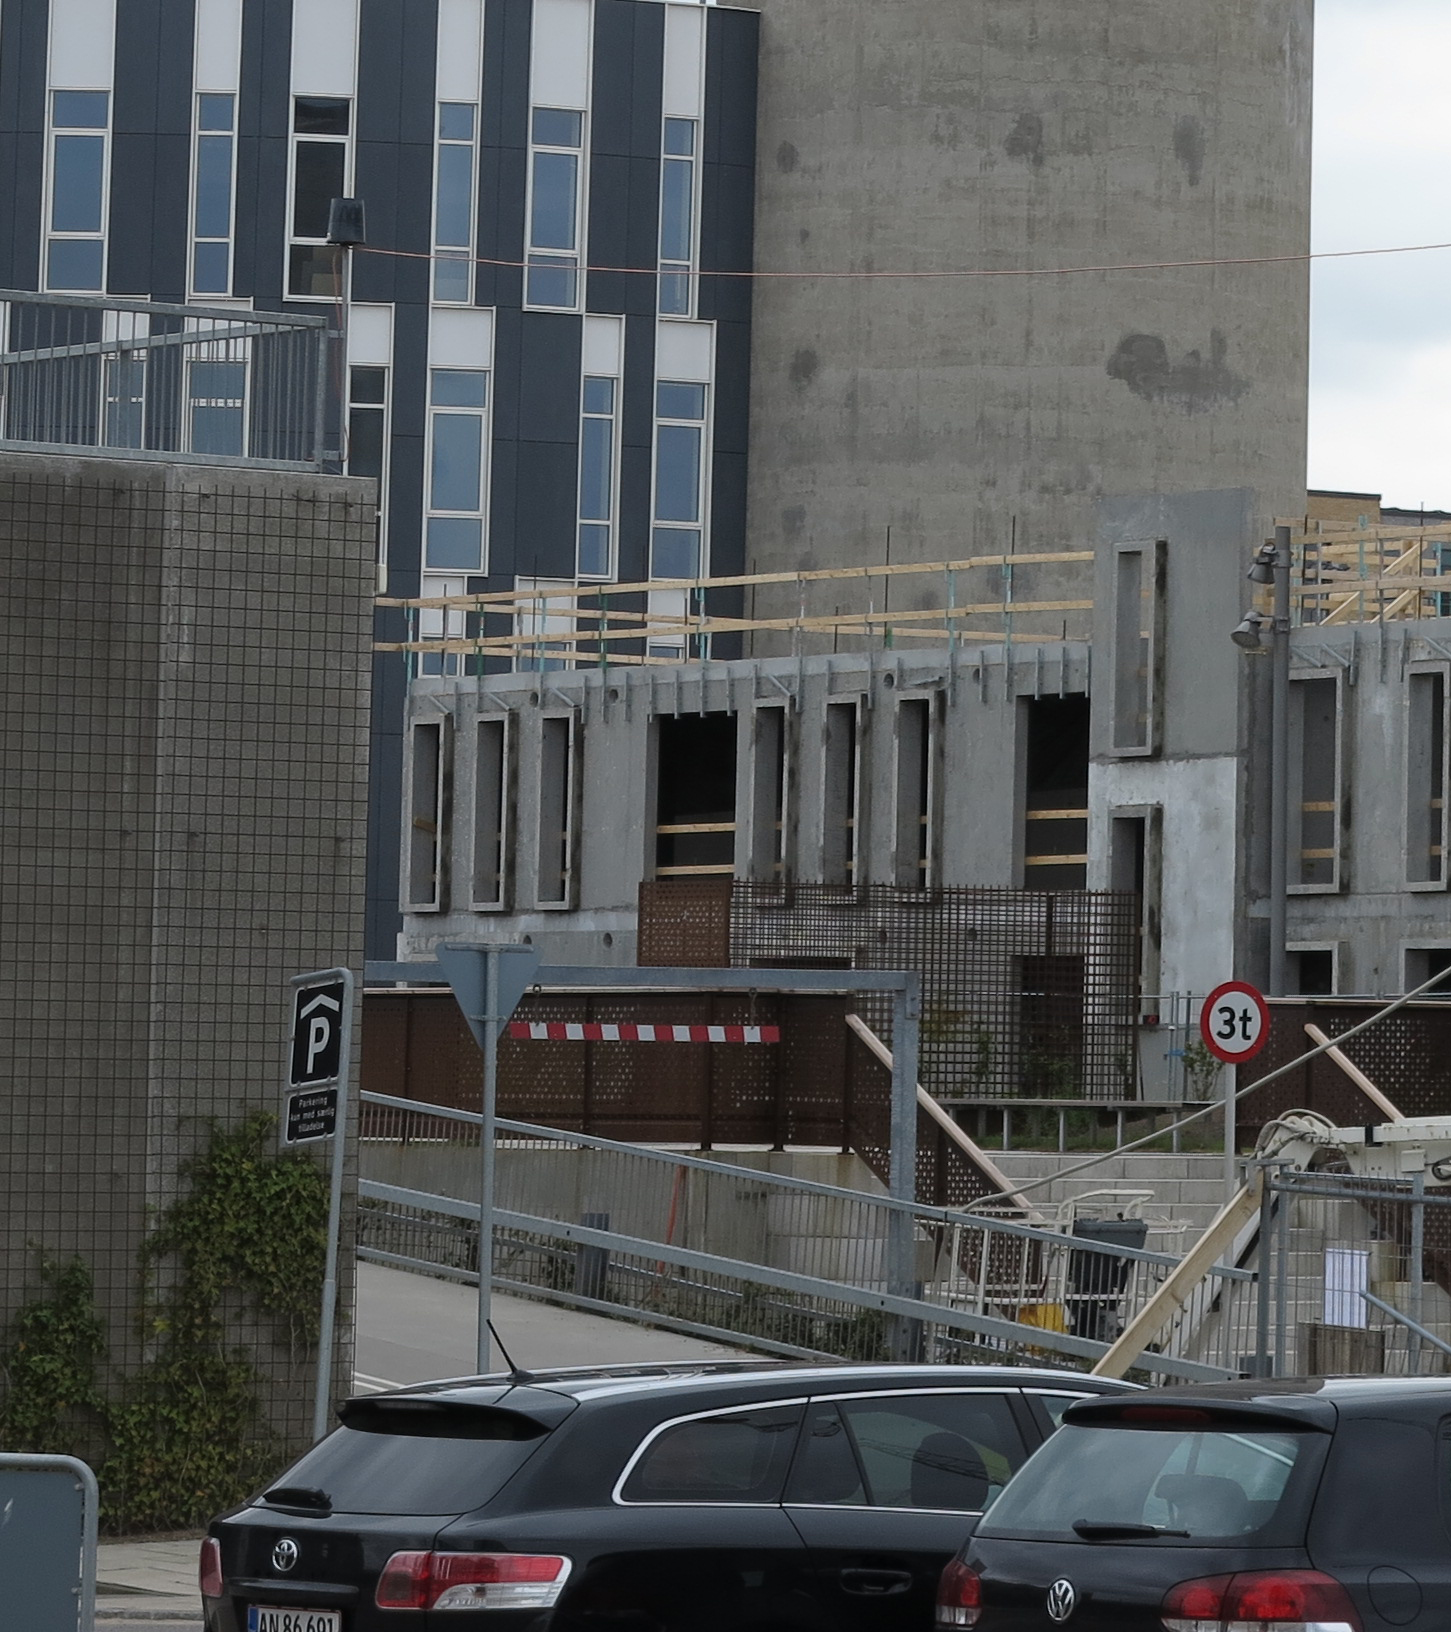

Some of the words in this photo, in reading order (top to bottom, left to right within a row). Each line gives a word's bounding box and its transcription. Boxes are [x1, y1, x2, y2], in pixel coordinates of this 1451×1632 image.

[1216, 1006, 1252, 1041] 3t
[306, 1016, 331, 1074] P
[298, 1097, 328, 1108] Parkering
[260, 1613, 279, 1632] AN
